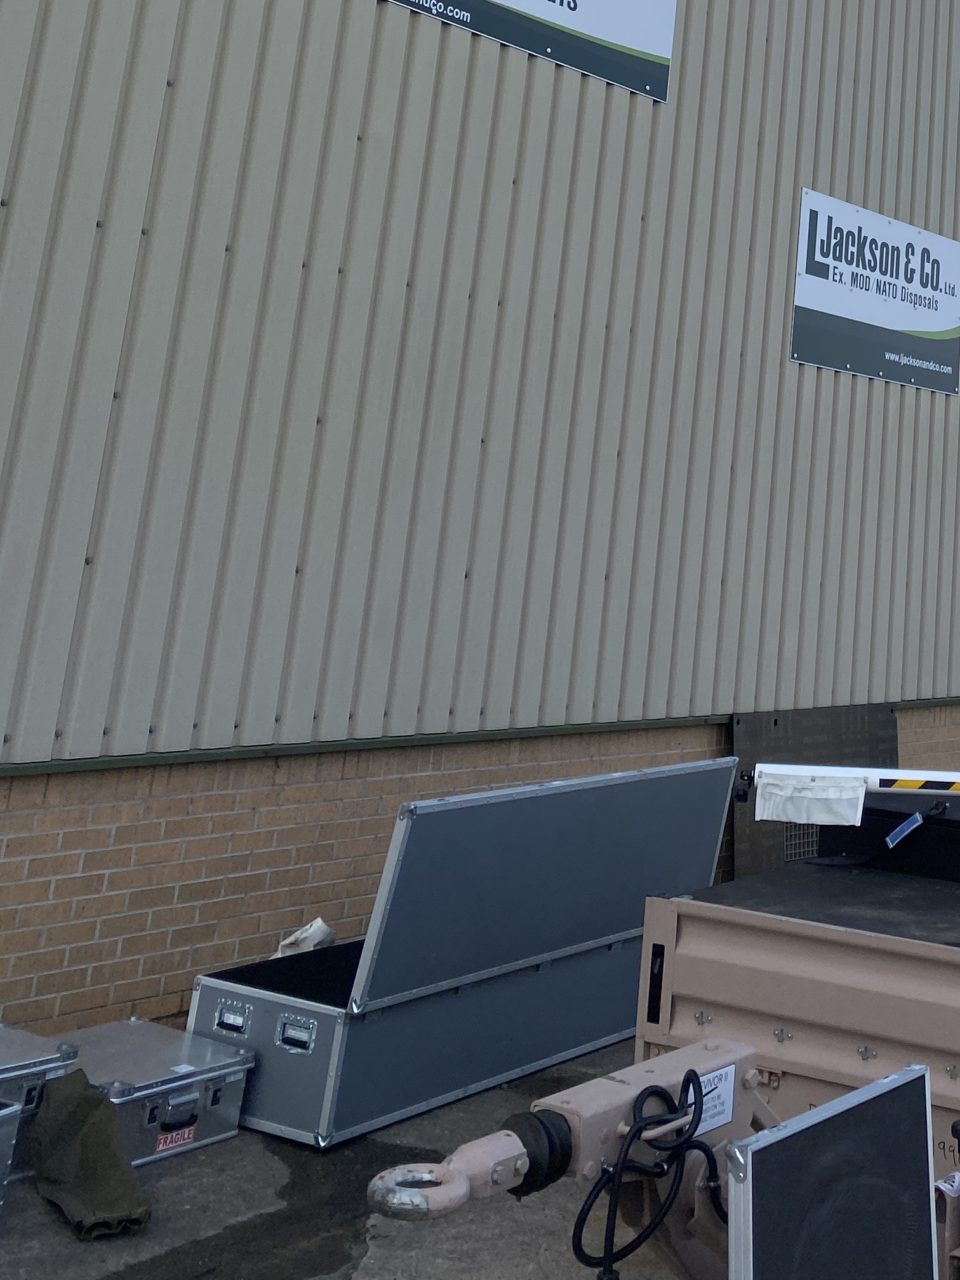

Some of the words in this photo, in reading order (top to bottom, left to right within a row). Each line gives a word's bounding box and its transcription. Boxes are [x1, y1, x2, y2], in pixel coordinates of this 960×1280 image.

[832, 266, 847, 286] Ex.
[900, 287, 939, 312] Disposals
[904, 242, 916, 284] &
[920, 247, 943, 293] Co.
[944, 281, 958, 298] Ltd.
[157, 1128, 194, 1150] FRAGILE
